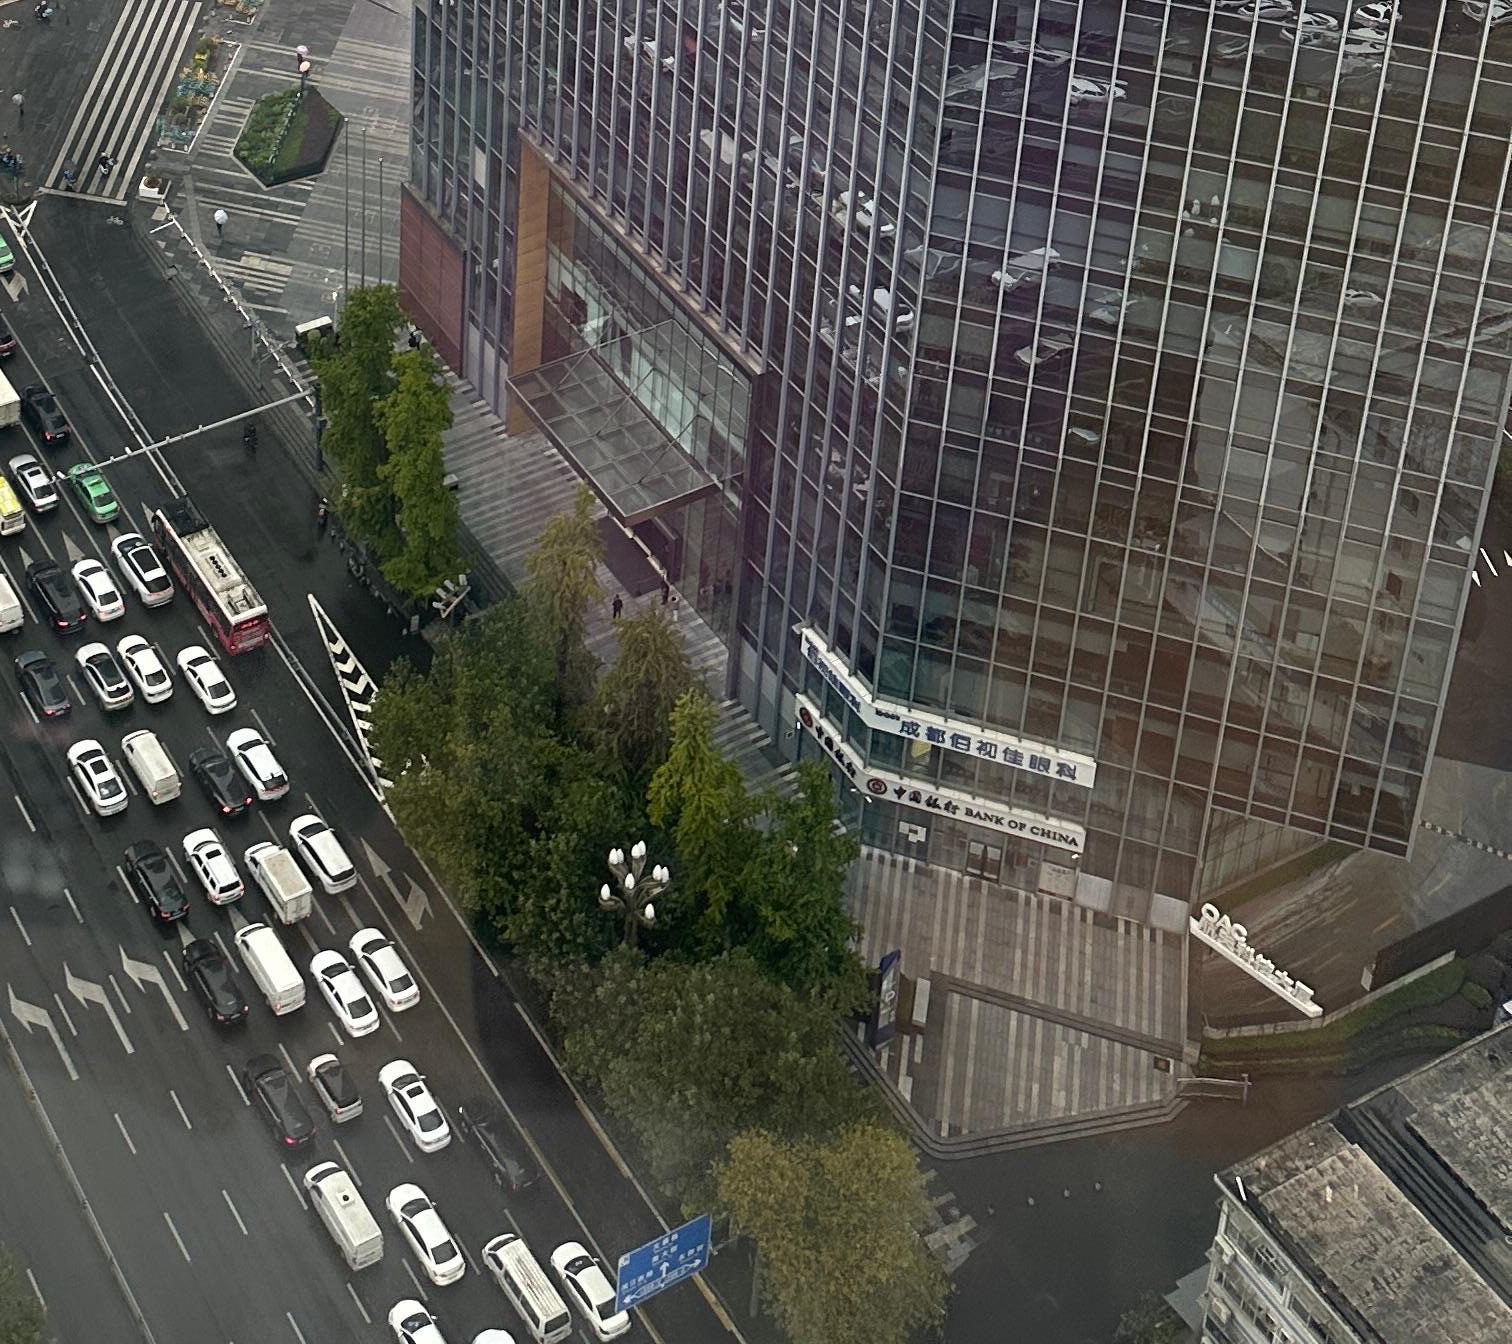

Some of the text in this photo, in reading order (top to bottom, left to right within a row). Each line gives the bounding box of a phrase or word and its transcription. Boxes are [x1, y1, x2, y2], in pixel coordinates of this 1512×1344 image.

[899, 719, 1077, 781] 成都佰视佳眼科
[893, 785, 1079, 848] 中国银行 BANK OF CHINA
